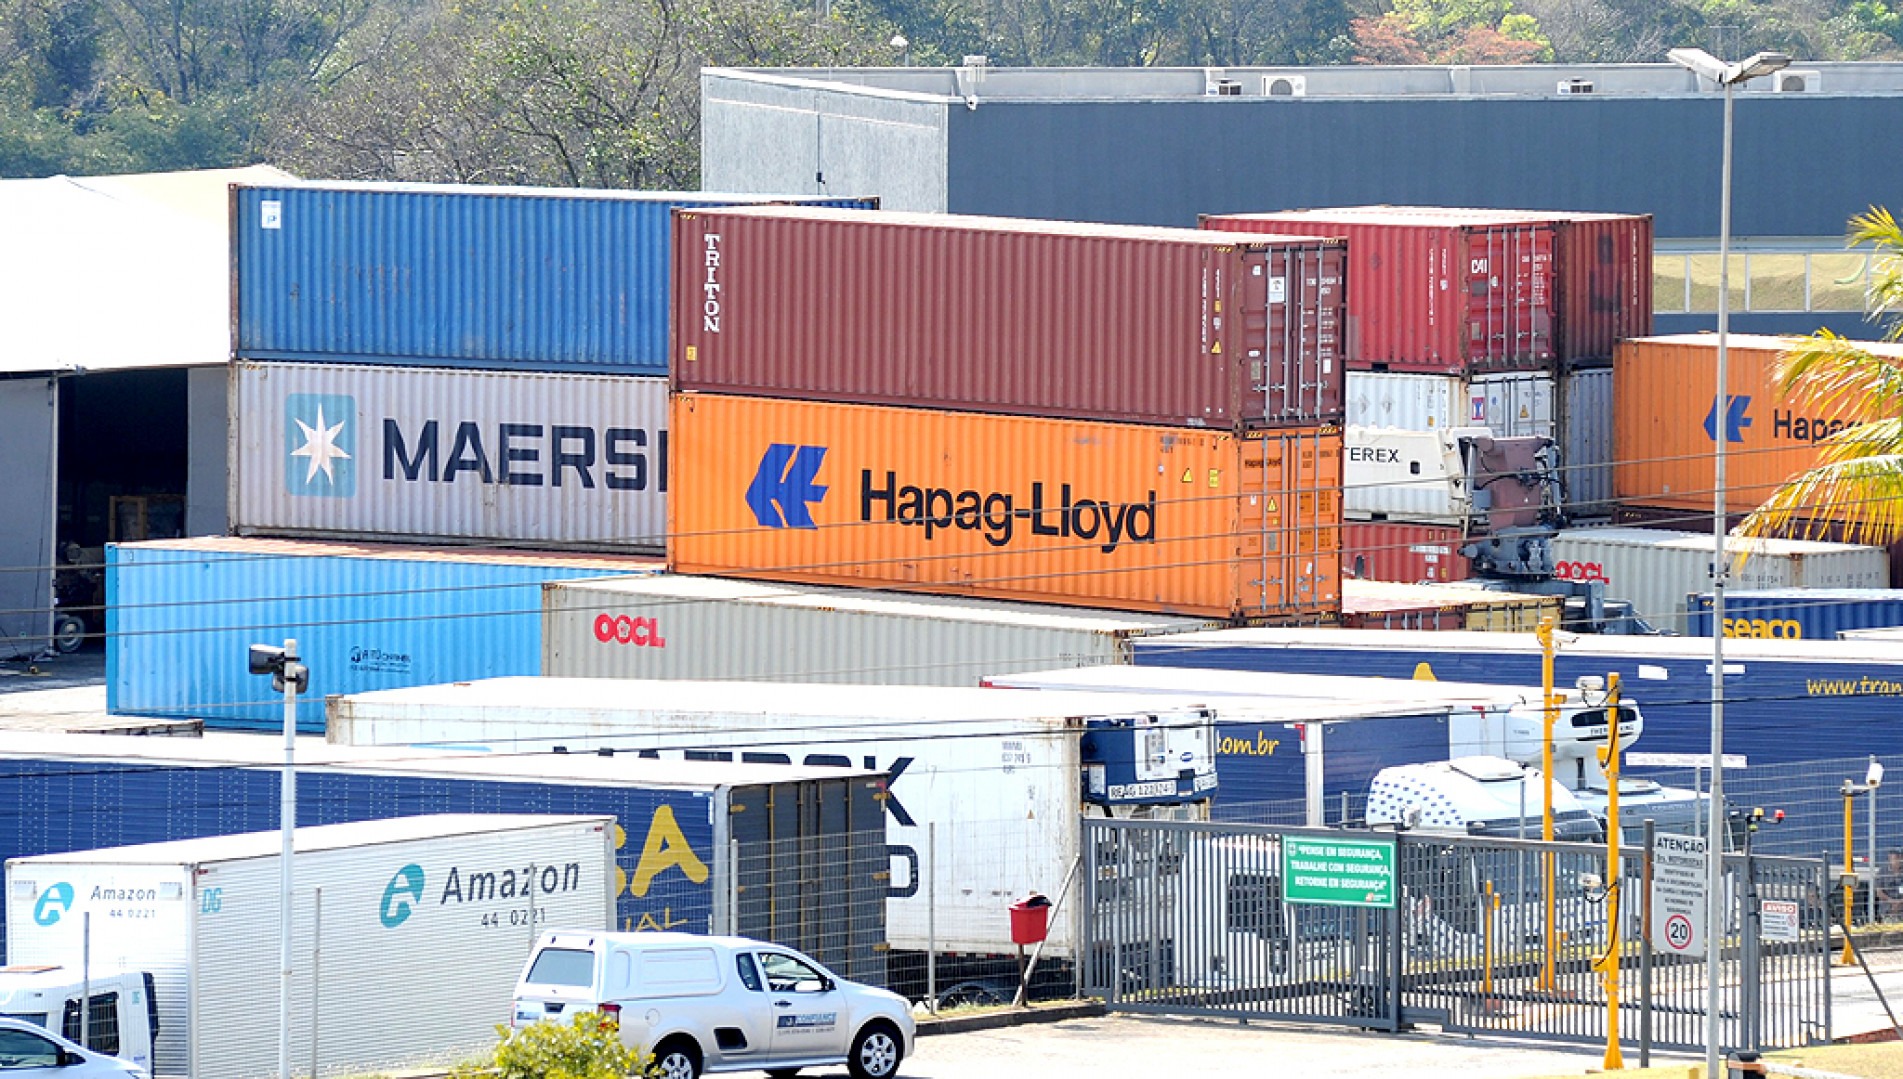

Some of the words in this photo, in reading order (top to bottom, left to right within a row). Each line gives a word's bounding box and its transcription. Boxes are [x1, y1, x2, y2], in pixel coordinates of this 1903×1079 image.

[704, 233, 720, 332] TRITON
[1344, 446, 1400, 464] EREX
[860, 468, 1156, 554] Hapag-Lloyd
[1722, 617, 1802, 640] seaco
[1657, 837, 1704, 853] ATENÇÃO
[90, 885, 156, 901] Amazon
[440, 861, 580, 905] Amazon
[202, 887, 223, 913] DG
[481, 911, 499, 928] 44
[1670, 922, 1688, 940] 20
